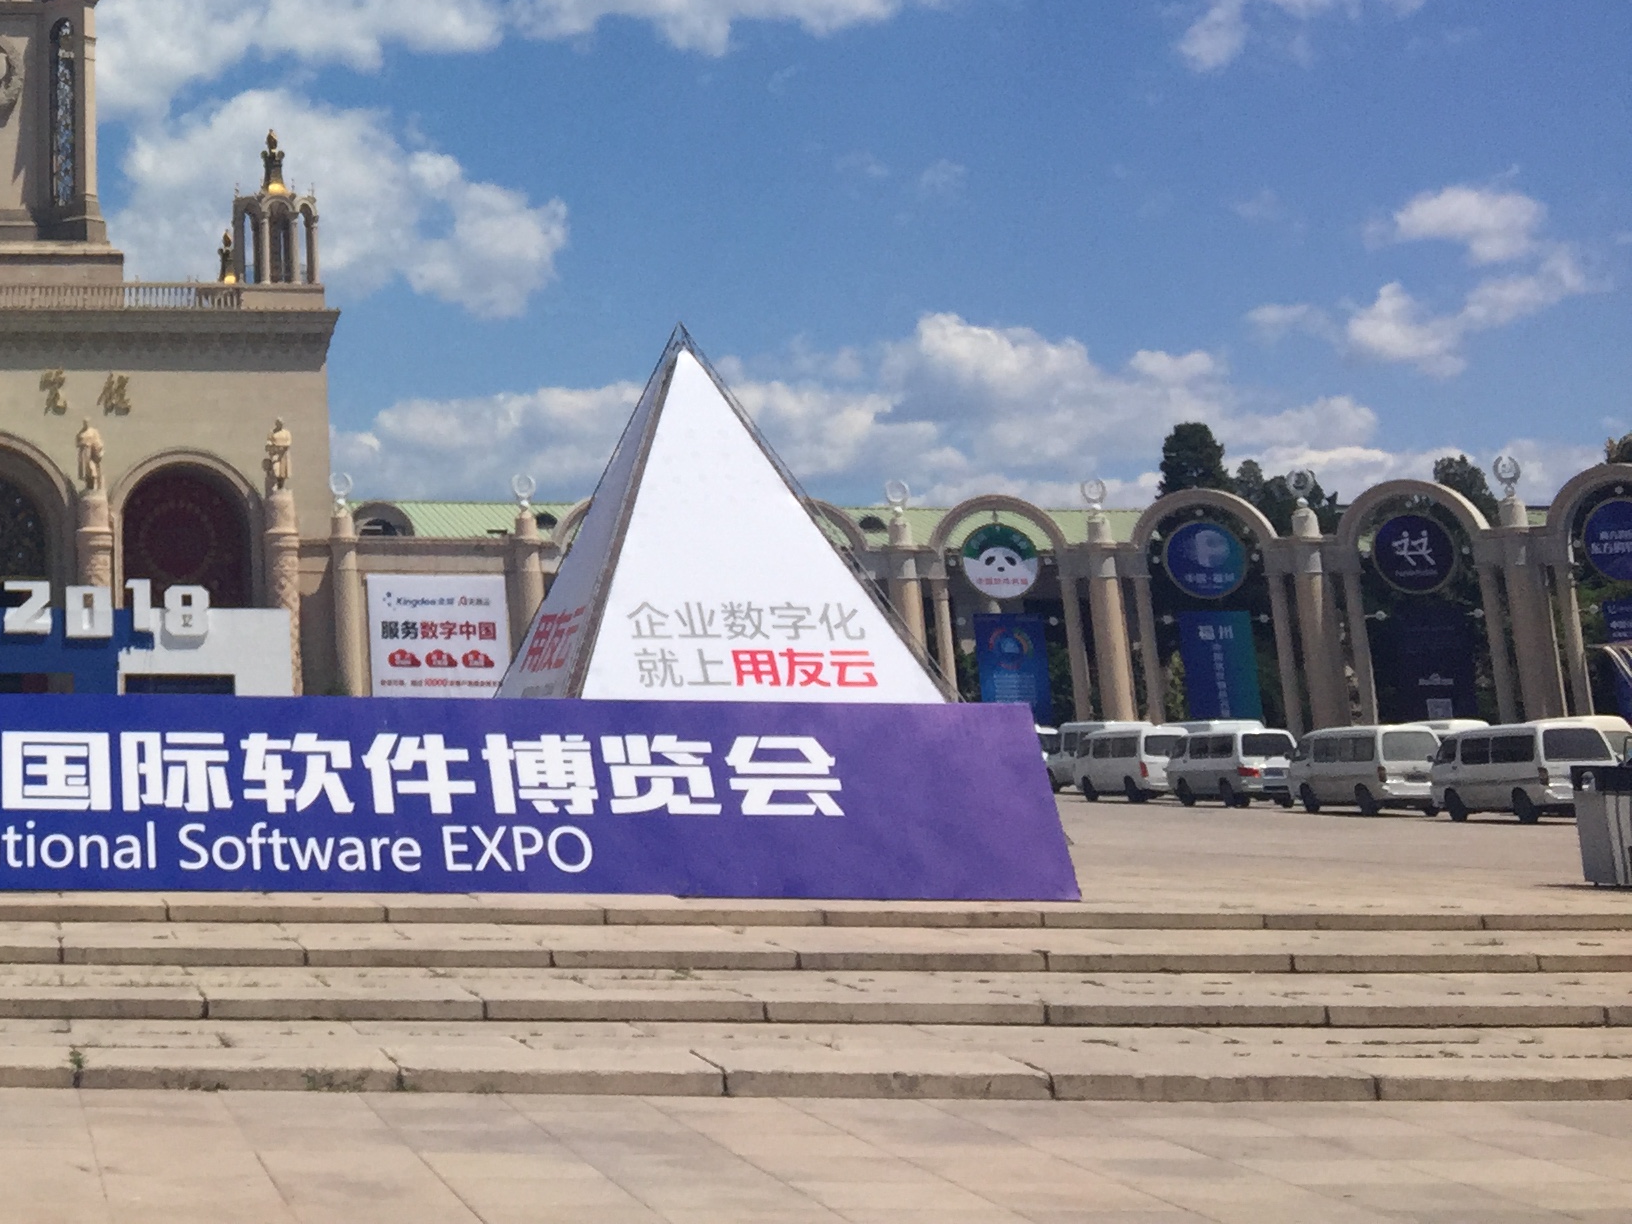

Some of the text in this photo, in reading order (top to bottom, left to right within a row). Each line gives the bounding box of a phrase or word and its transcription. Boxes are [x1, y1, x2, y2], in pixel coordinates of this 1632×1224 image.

[380, 620, 497, 641] 服务数字中国
[626, 600, 867, 642] 企业数字化
[636, 645, 879, 690] 就上用友云
[178, 823, 422, 872] Software
[443, 825, 593, 873] EXPO
